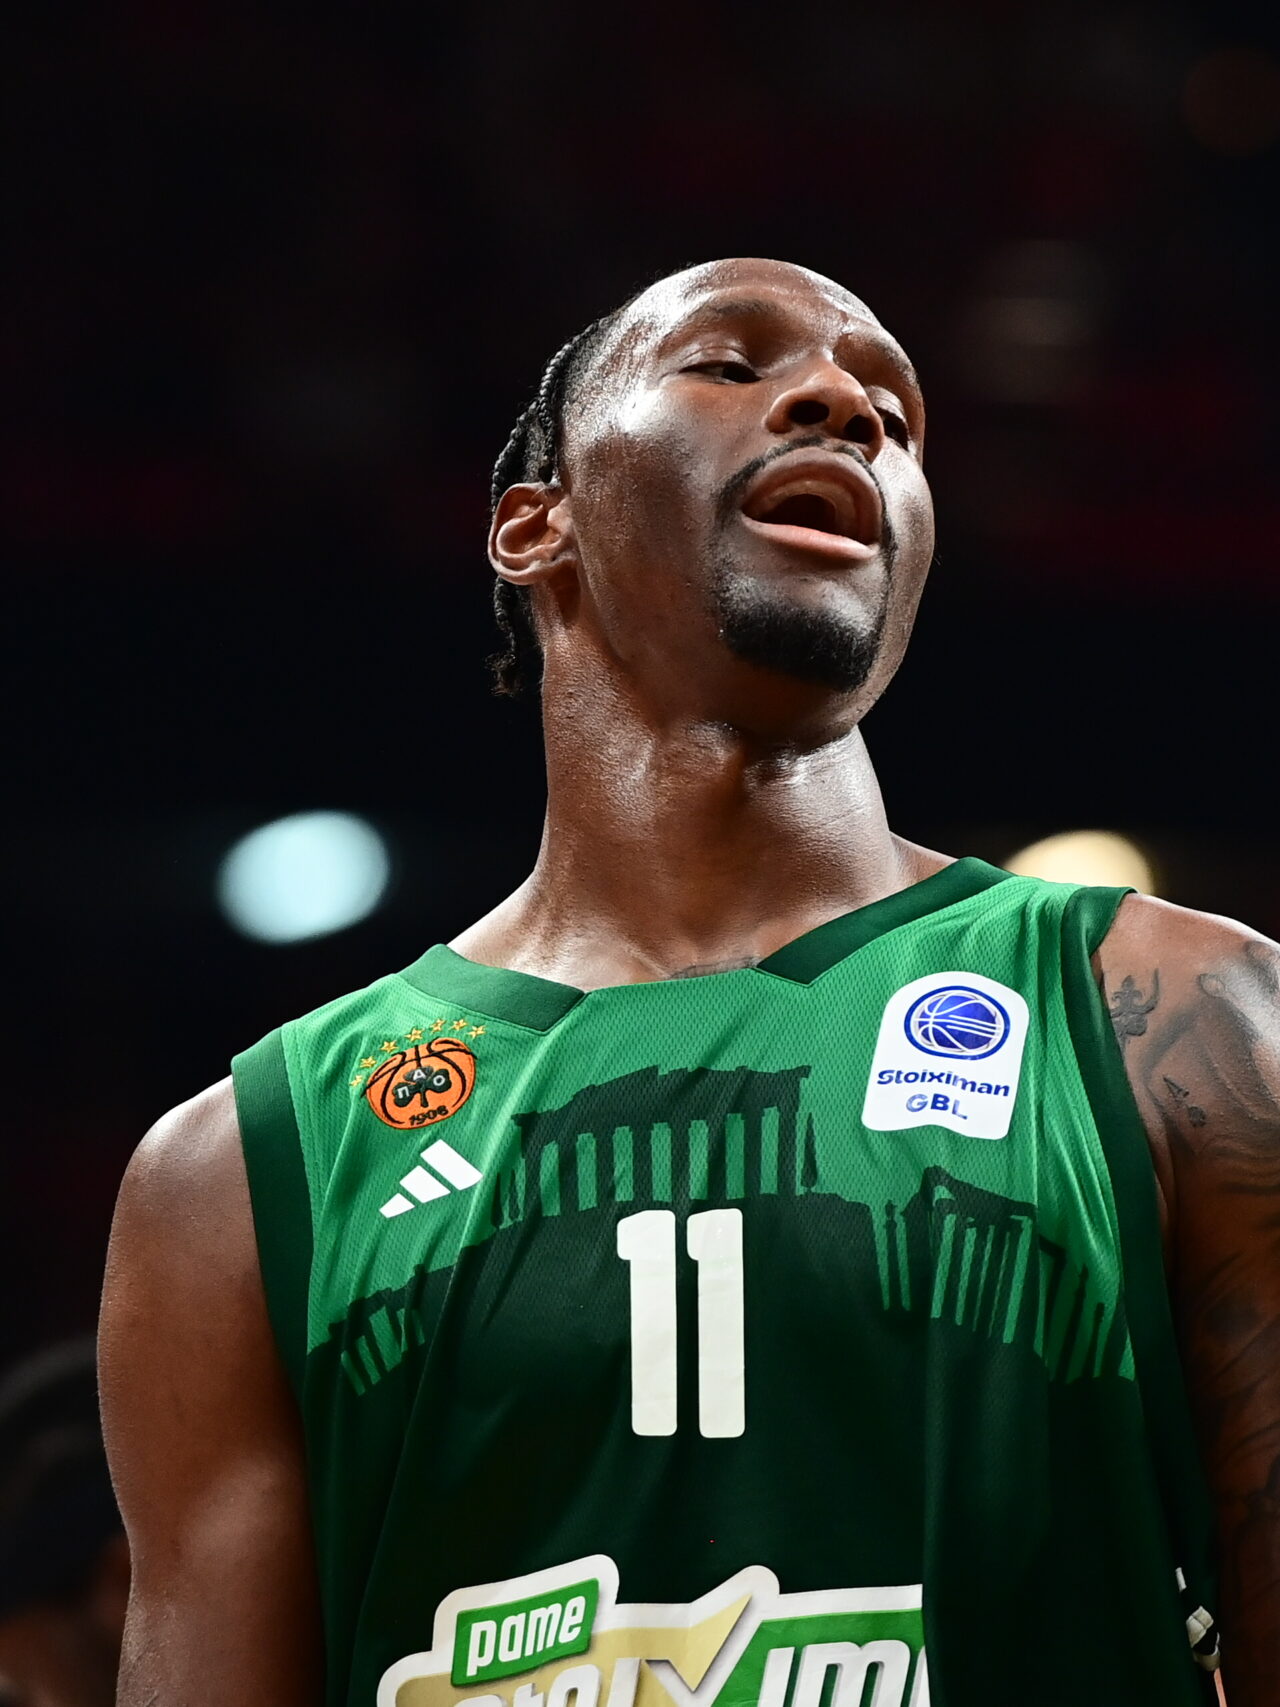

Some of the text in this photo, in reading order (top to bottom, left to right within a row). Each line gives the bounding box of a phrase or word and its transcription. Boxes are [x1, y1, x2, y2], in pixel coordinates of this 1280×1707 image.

[877, 1068, 1010, 1097] Stoiximan
[906, 1093, 968, 1120] GBL
[616, 1208, 745, 1438] 11
[466, 1595, 586, 1677] pame
